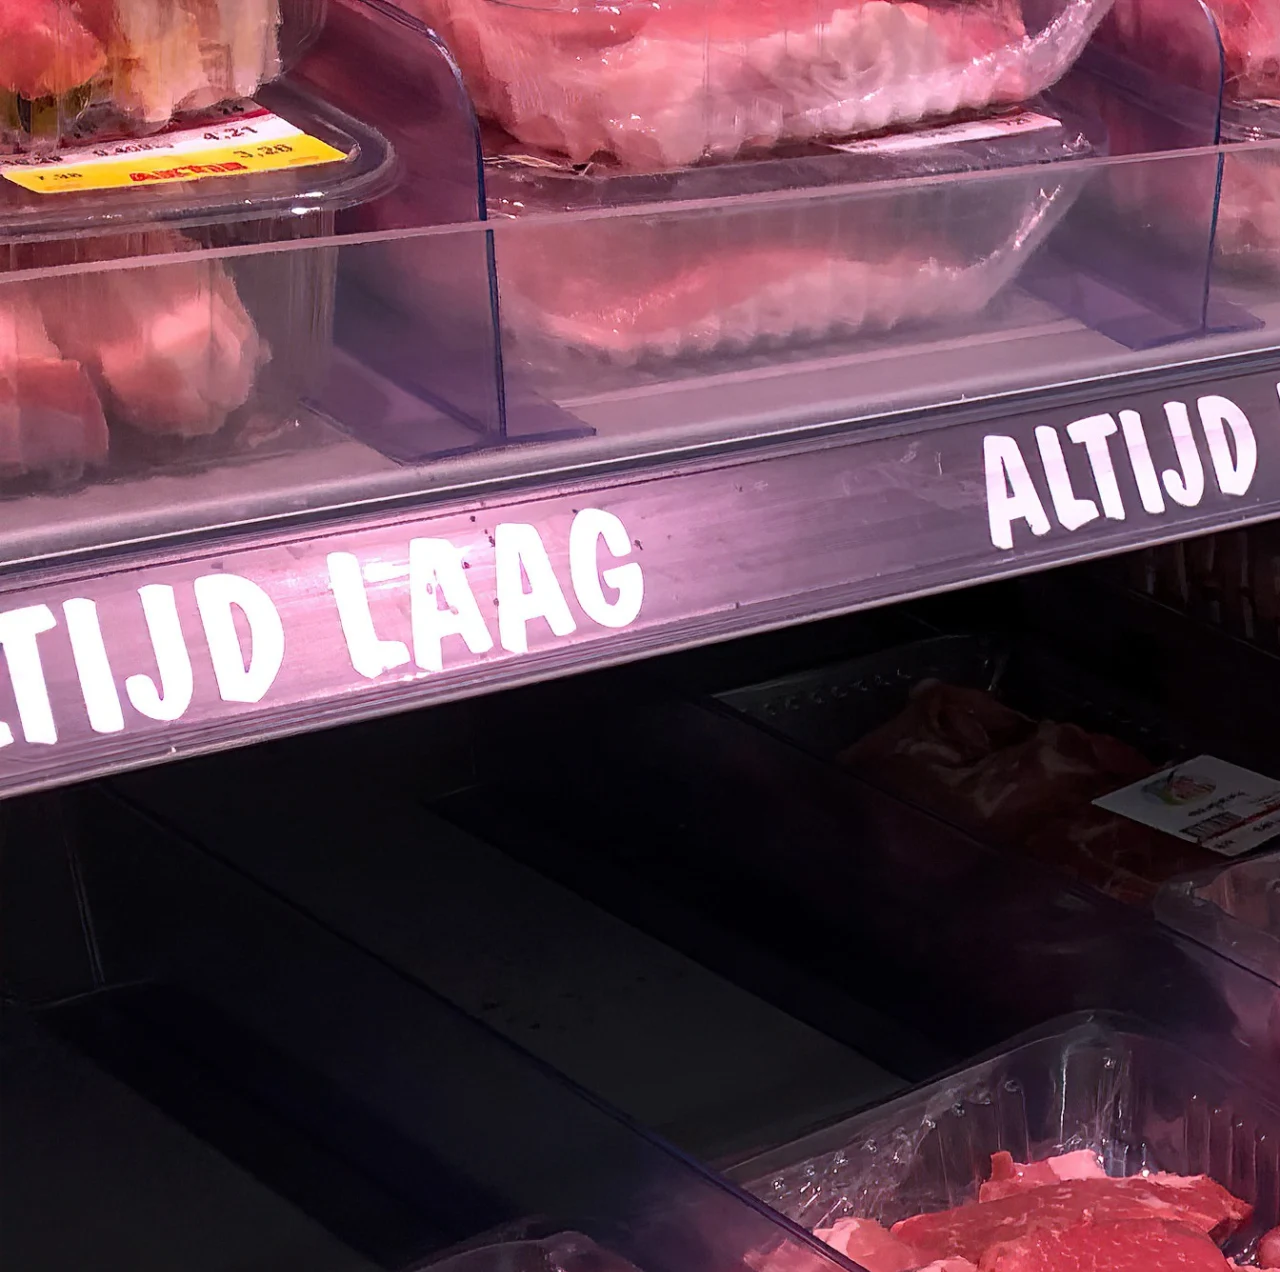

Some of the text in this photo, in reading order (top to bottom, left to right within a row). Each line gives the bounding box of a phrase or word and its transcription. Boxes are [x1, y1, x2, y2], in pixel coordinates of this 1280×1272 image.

[983, 394, 1258, 549] ALTIJD
[0, 507, 645, 748] TIJD LAAG
